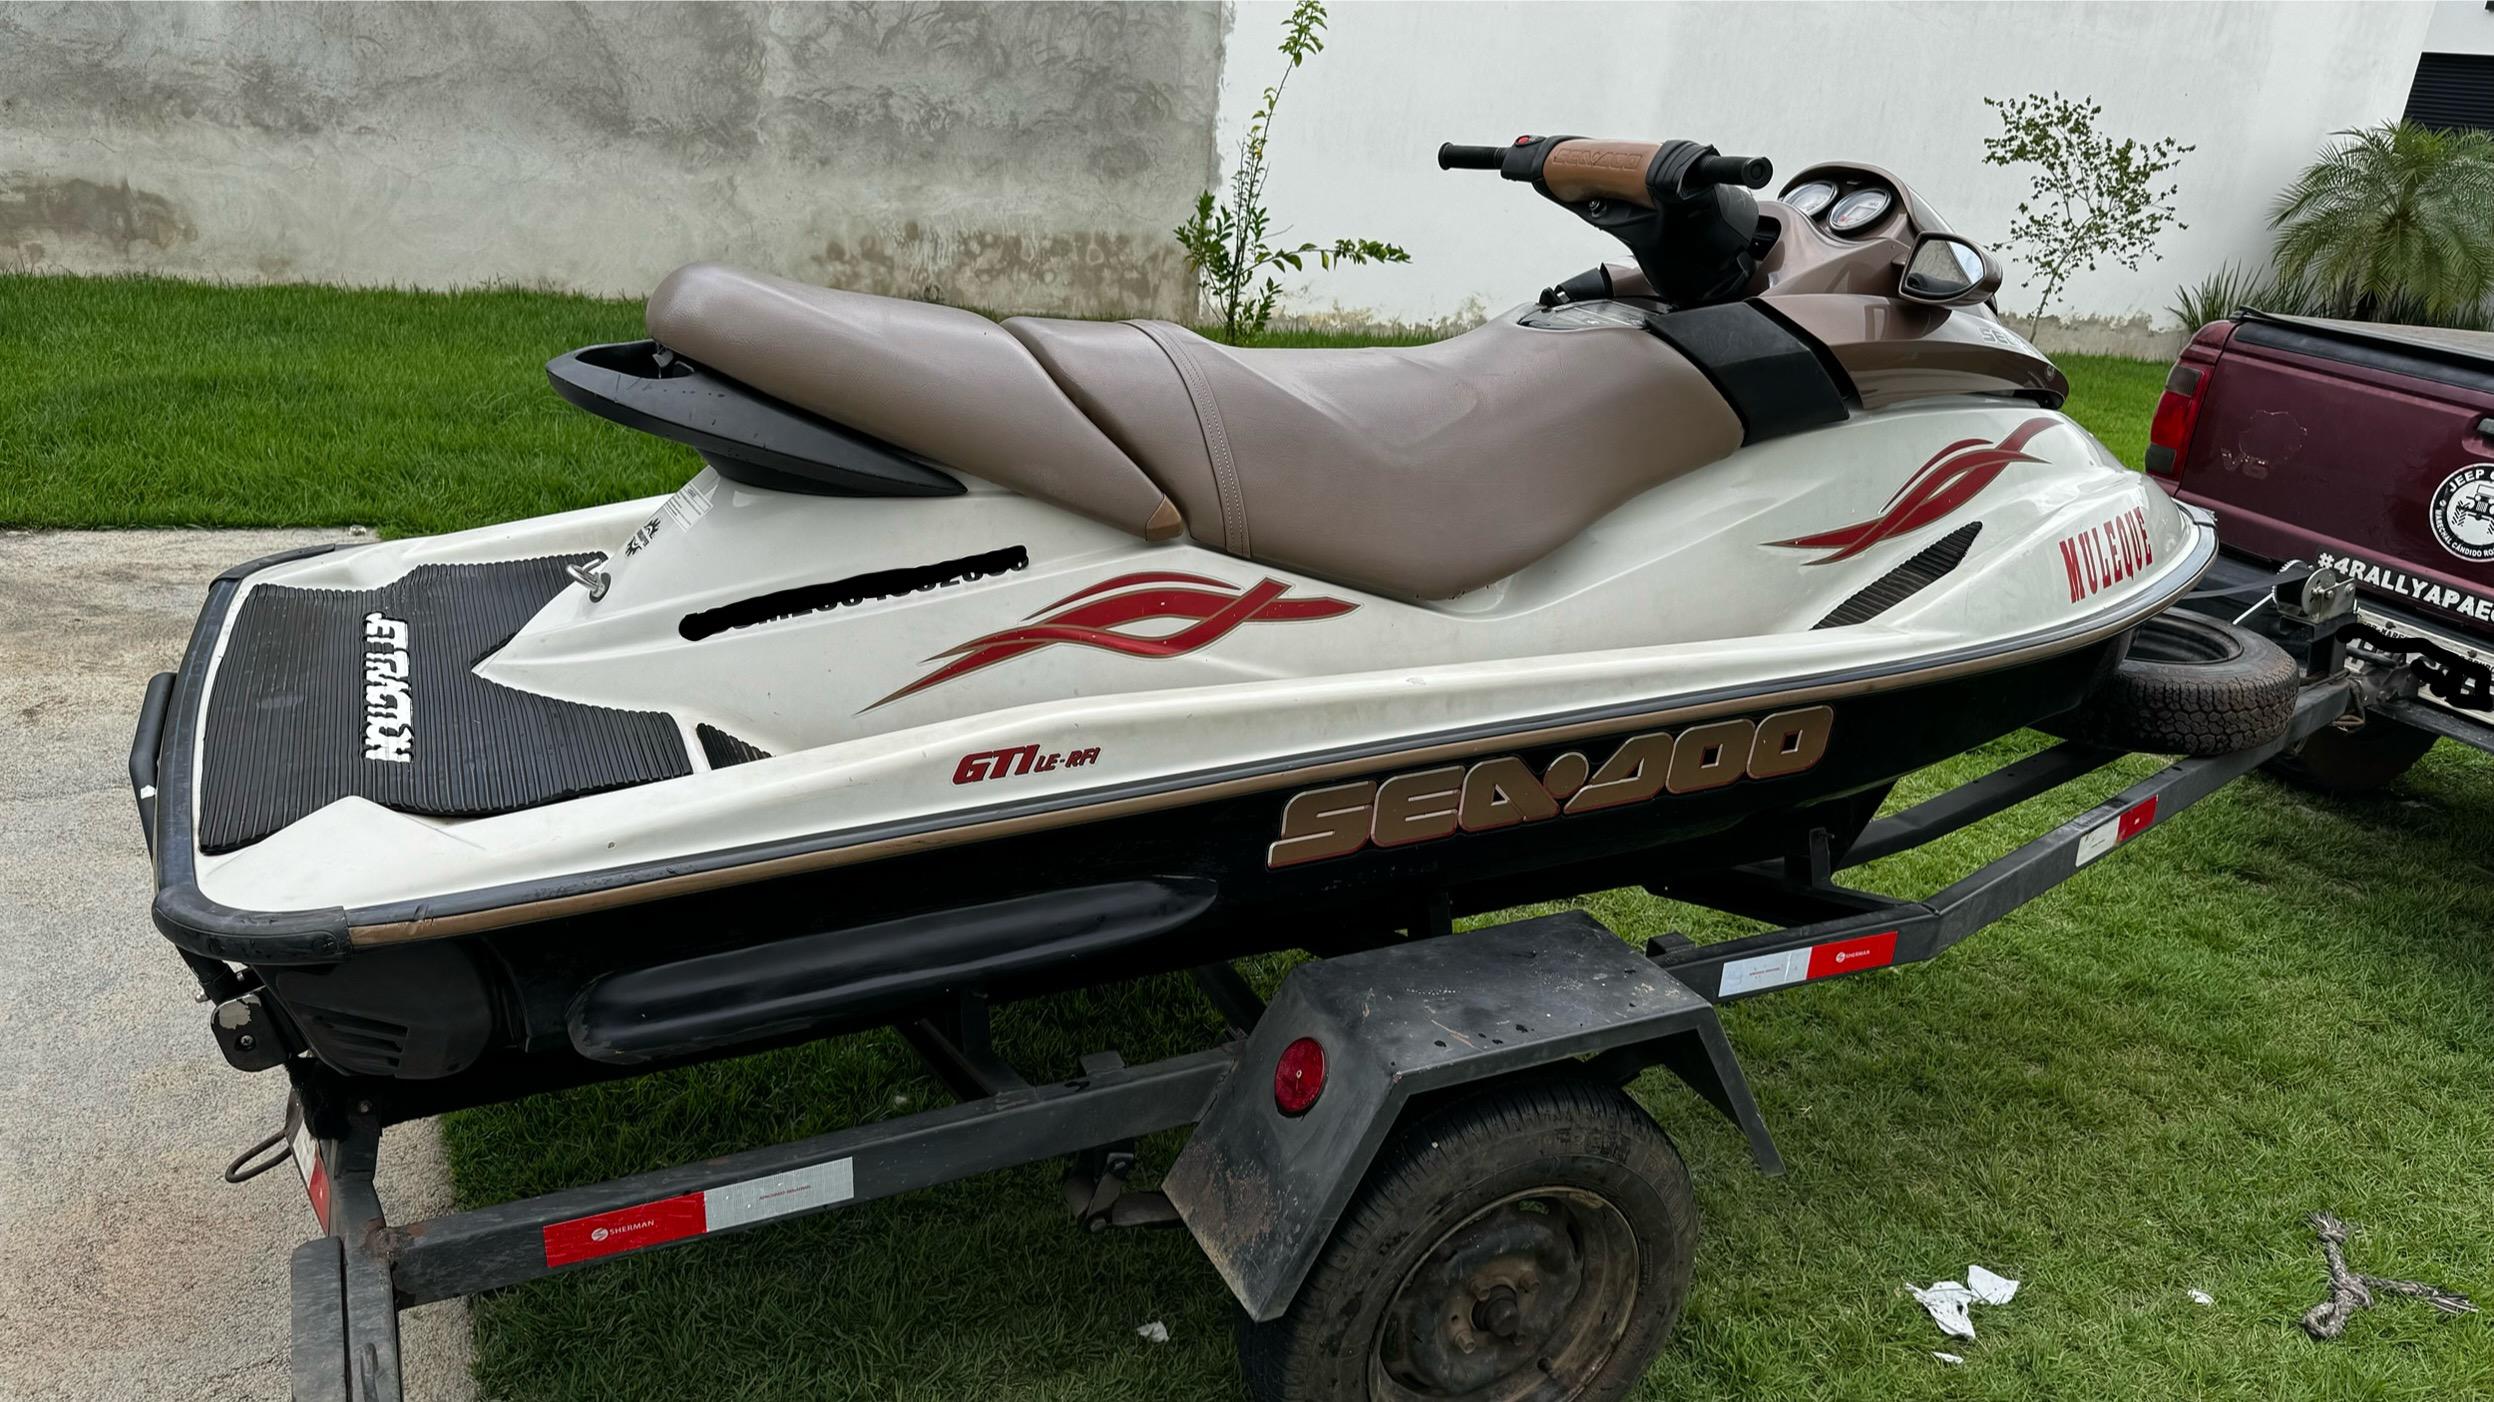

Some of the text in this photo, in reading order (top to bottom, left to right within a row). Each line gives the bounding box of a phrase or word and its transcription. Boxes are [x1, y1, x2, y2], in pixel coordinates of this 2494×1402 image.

[2449, 469, 2485, 492] JEEP
[2059, 506, 2153, 604] MULEQUE
[2317, 552, 2494, 624] #4RALLYAPAE
[609, 1219, 655, 1236] SHERMAN
